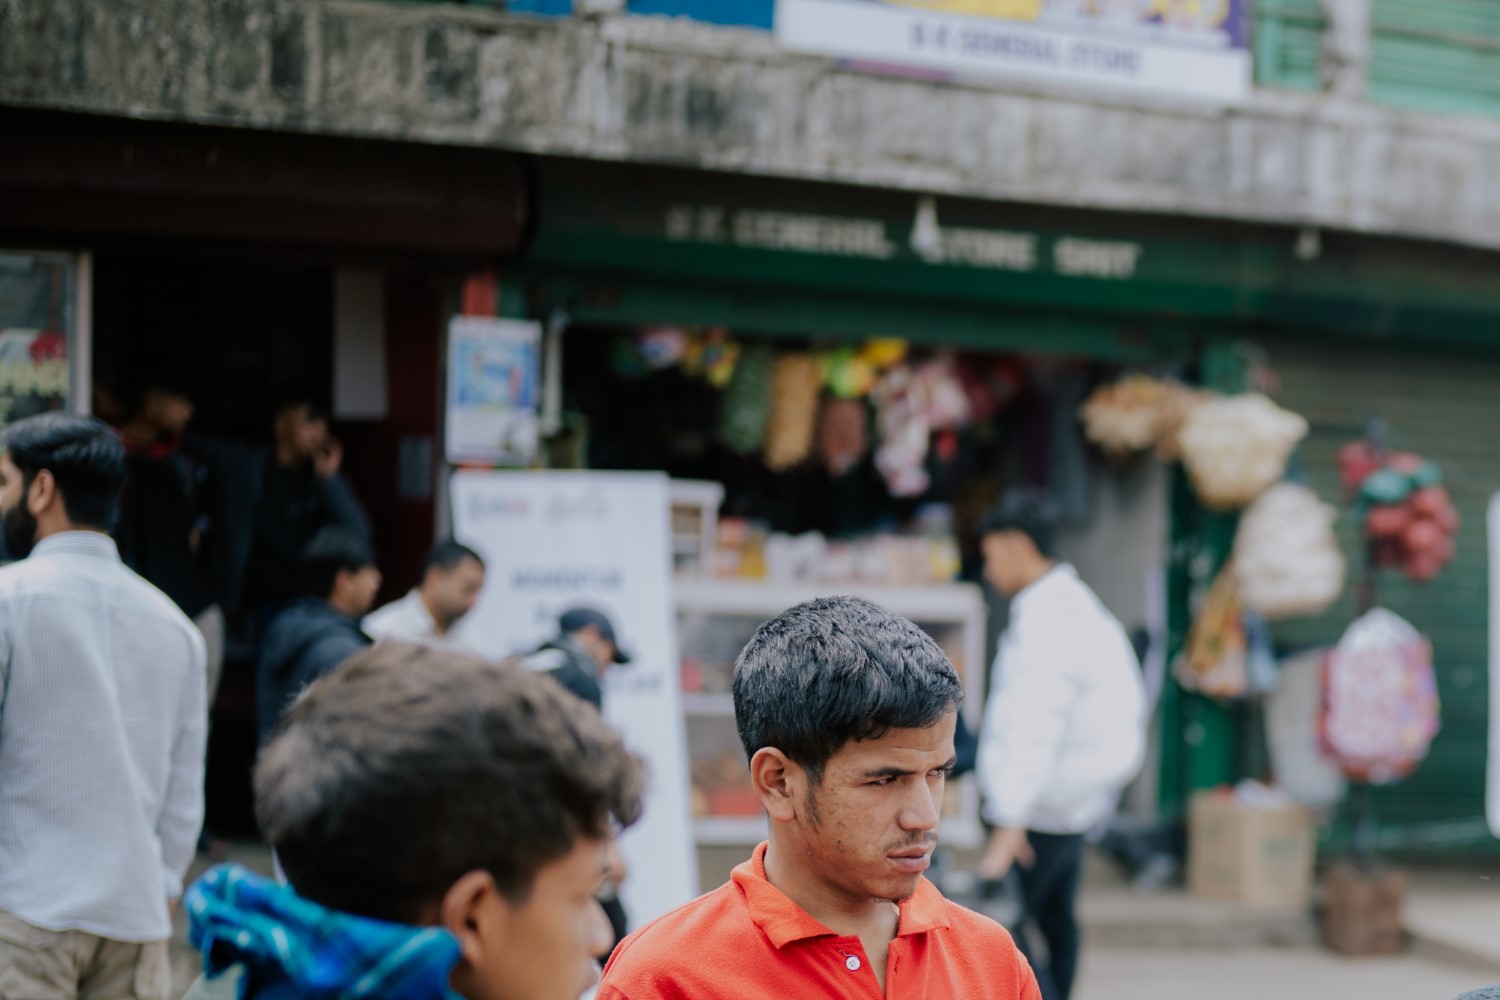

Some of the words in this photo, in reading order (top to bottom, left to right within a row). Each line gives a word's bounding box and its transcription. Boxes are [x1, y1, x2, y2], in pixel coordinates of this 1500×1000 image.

[957, 27, 1061, 65] GENERAL
[1067, 41, 1145, 76] STORE
[733, 212, 896, 258] GENERAL
